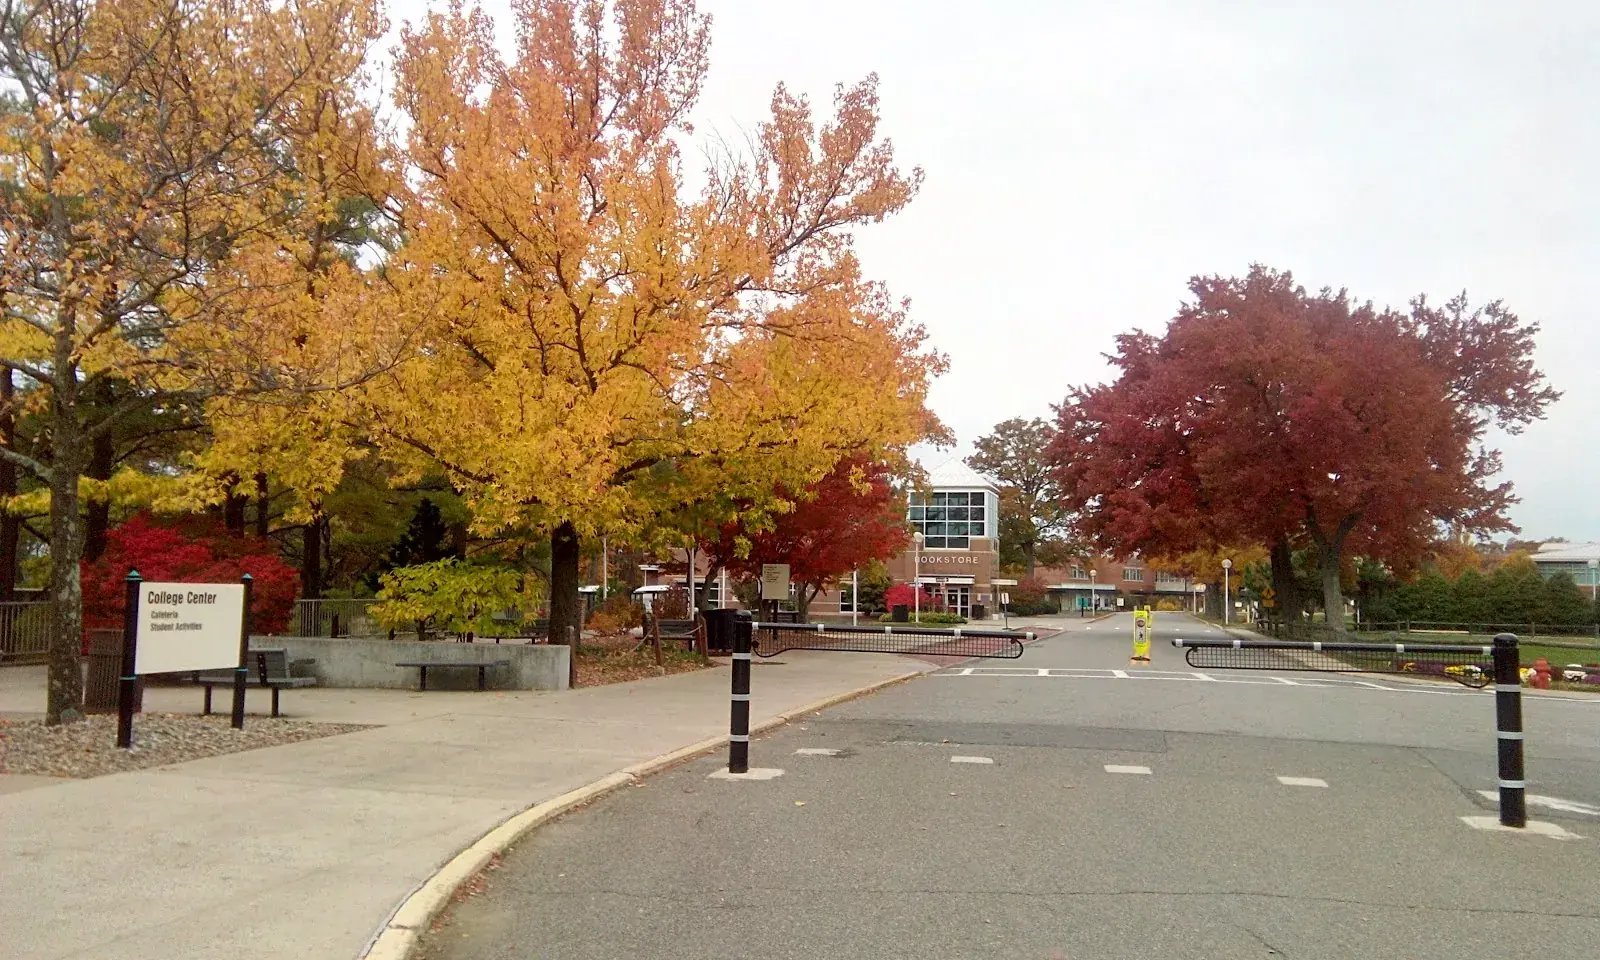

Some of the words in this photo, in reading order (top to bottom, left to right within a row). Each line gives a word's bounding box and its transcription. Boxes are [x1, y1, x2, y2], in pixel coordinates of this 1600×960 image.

[147, 591, 184, 606] College
[187, 591, 217, 604] Center
[151, 610, 179, 619] Cafeteria
[150, 622, 174, 631] Student
[175, 622, 203, 631] Activities
